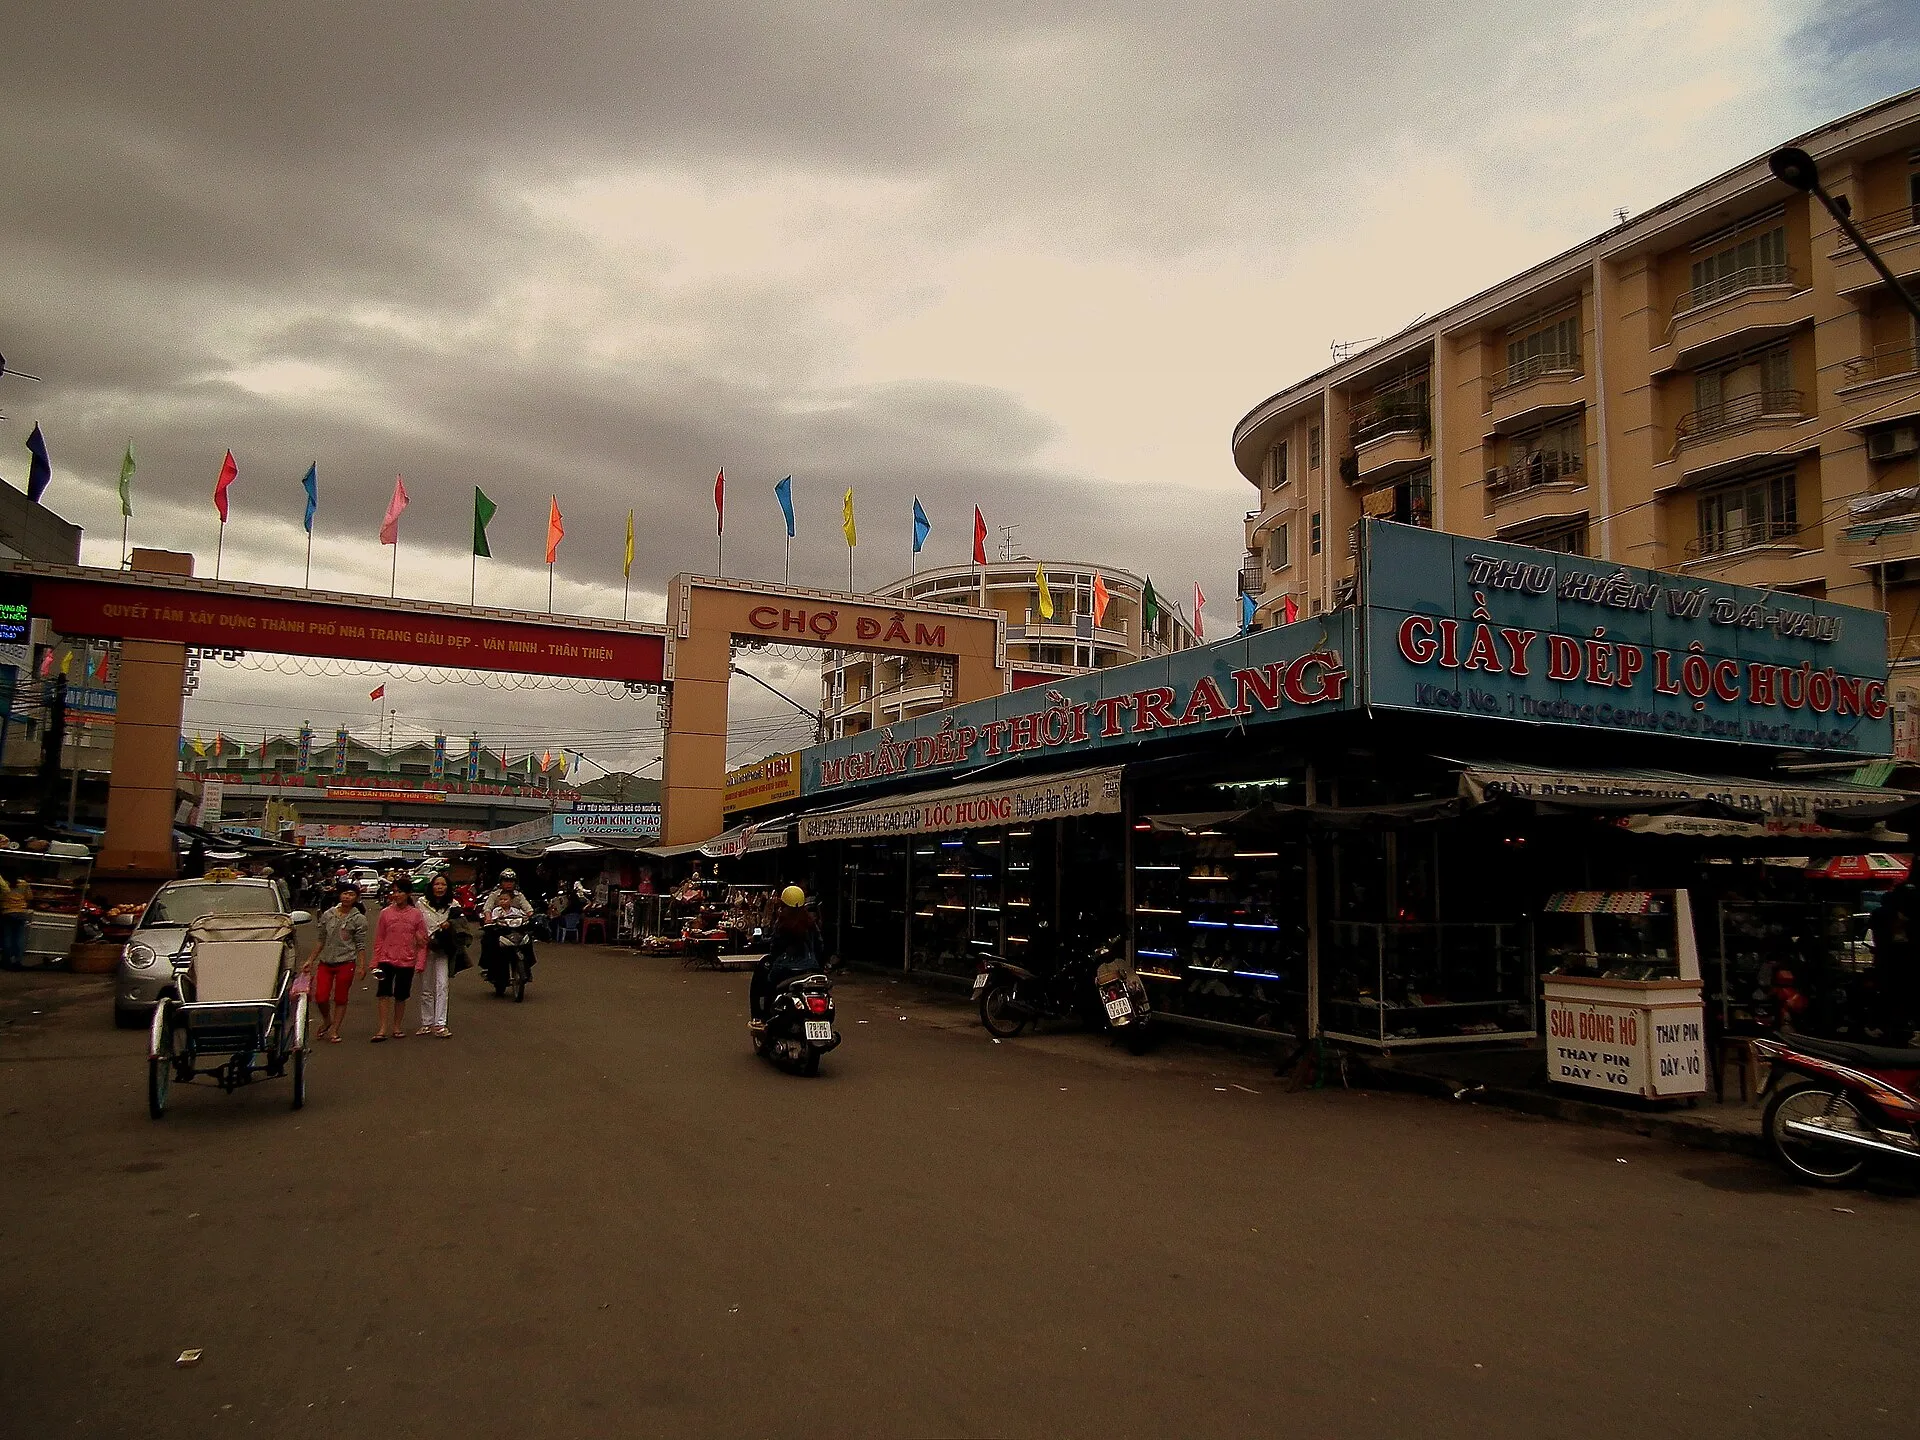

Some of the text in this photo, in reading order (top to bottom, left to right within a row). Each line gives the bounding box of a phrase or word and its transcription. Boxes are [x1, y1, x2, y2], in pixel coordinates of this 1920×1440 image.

[1465, 553, 1556, 594] THU
[102, 601, 149, 619] QUYẾT
[152, 607, 184, 624] TÂM
[187, 609, 216, 626] XÂY
[219, 613, 257, 631] DỰNG
[260, 617, 305, 634] THÀNH
[308, 619, 337, 636] PHỐ
[339, 625, 366, 639] NHA
[369, 627, 411, 643] TRANG
[415, 630, 444, 646] GIÀU
[447, 634, 472, 650] ĐẸP
[483, 637, 506, 651] VĂN
[508, 639, 538, 653] MINH
[548, 643, 579, 657] THÂN
[582, 646, 614, 662] THIỆN
[749, 605, 838, 640] CHỢ
[1397, 591, 1504, 677] GIẦY
[1547, 626, 1644, 689] DÉP
[1653, 640, 1742, 712] LỘC
[1747, 660, 1889, 720] HƯƠNG
[843, 727, 914, 782] GIẦY
[914, 714, 977, 769] DÉP
[977, 688, 1091, 758] THỜI
[1093, 649, 1350, 738] TRANG
[1466, 688, 1501, 713] No.
[1506, 692, 1515, 714] 1
[1519, 693, 1594, 724] Trading
[1596, 702, 1660, 729] Centre
[765, 756, 793, 781] HBH
[565, 815, 586, 826] CHỢ
[610, 814, 632, 825] KÍNH
[635, 814, 660, 825] CHÀO
[577, 826, 629, 834] Welcome
[884, 811, 901, 830] CAO
[956, 795, 1012, 824] HƯƠNG
[1550, 1001, 1638, 1047] SỬA ĐỒNG HỒ
[1656, 1022, 1699, 1044] THAY PIN
[1557, 1047, 1630, 1068] THAY PIN
[1561, 1064, 1591, 1080] DÂY
[1606, 1069, 1628, 1085] VỎ
[1686, 1049, 1700, 1075] VỎ
